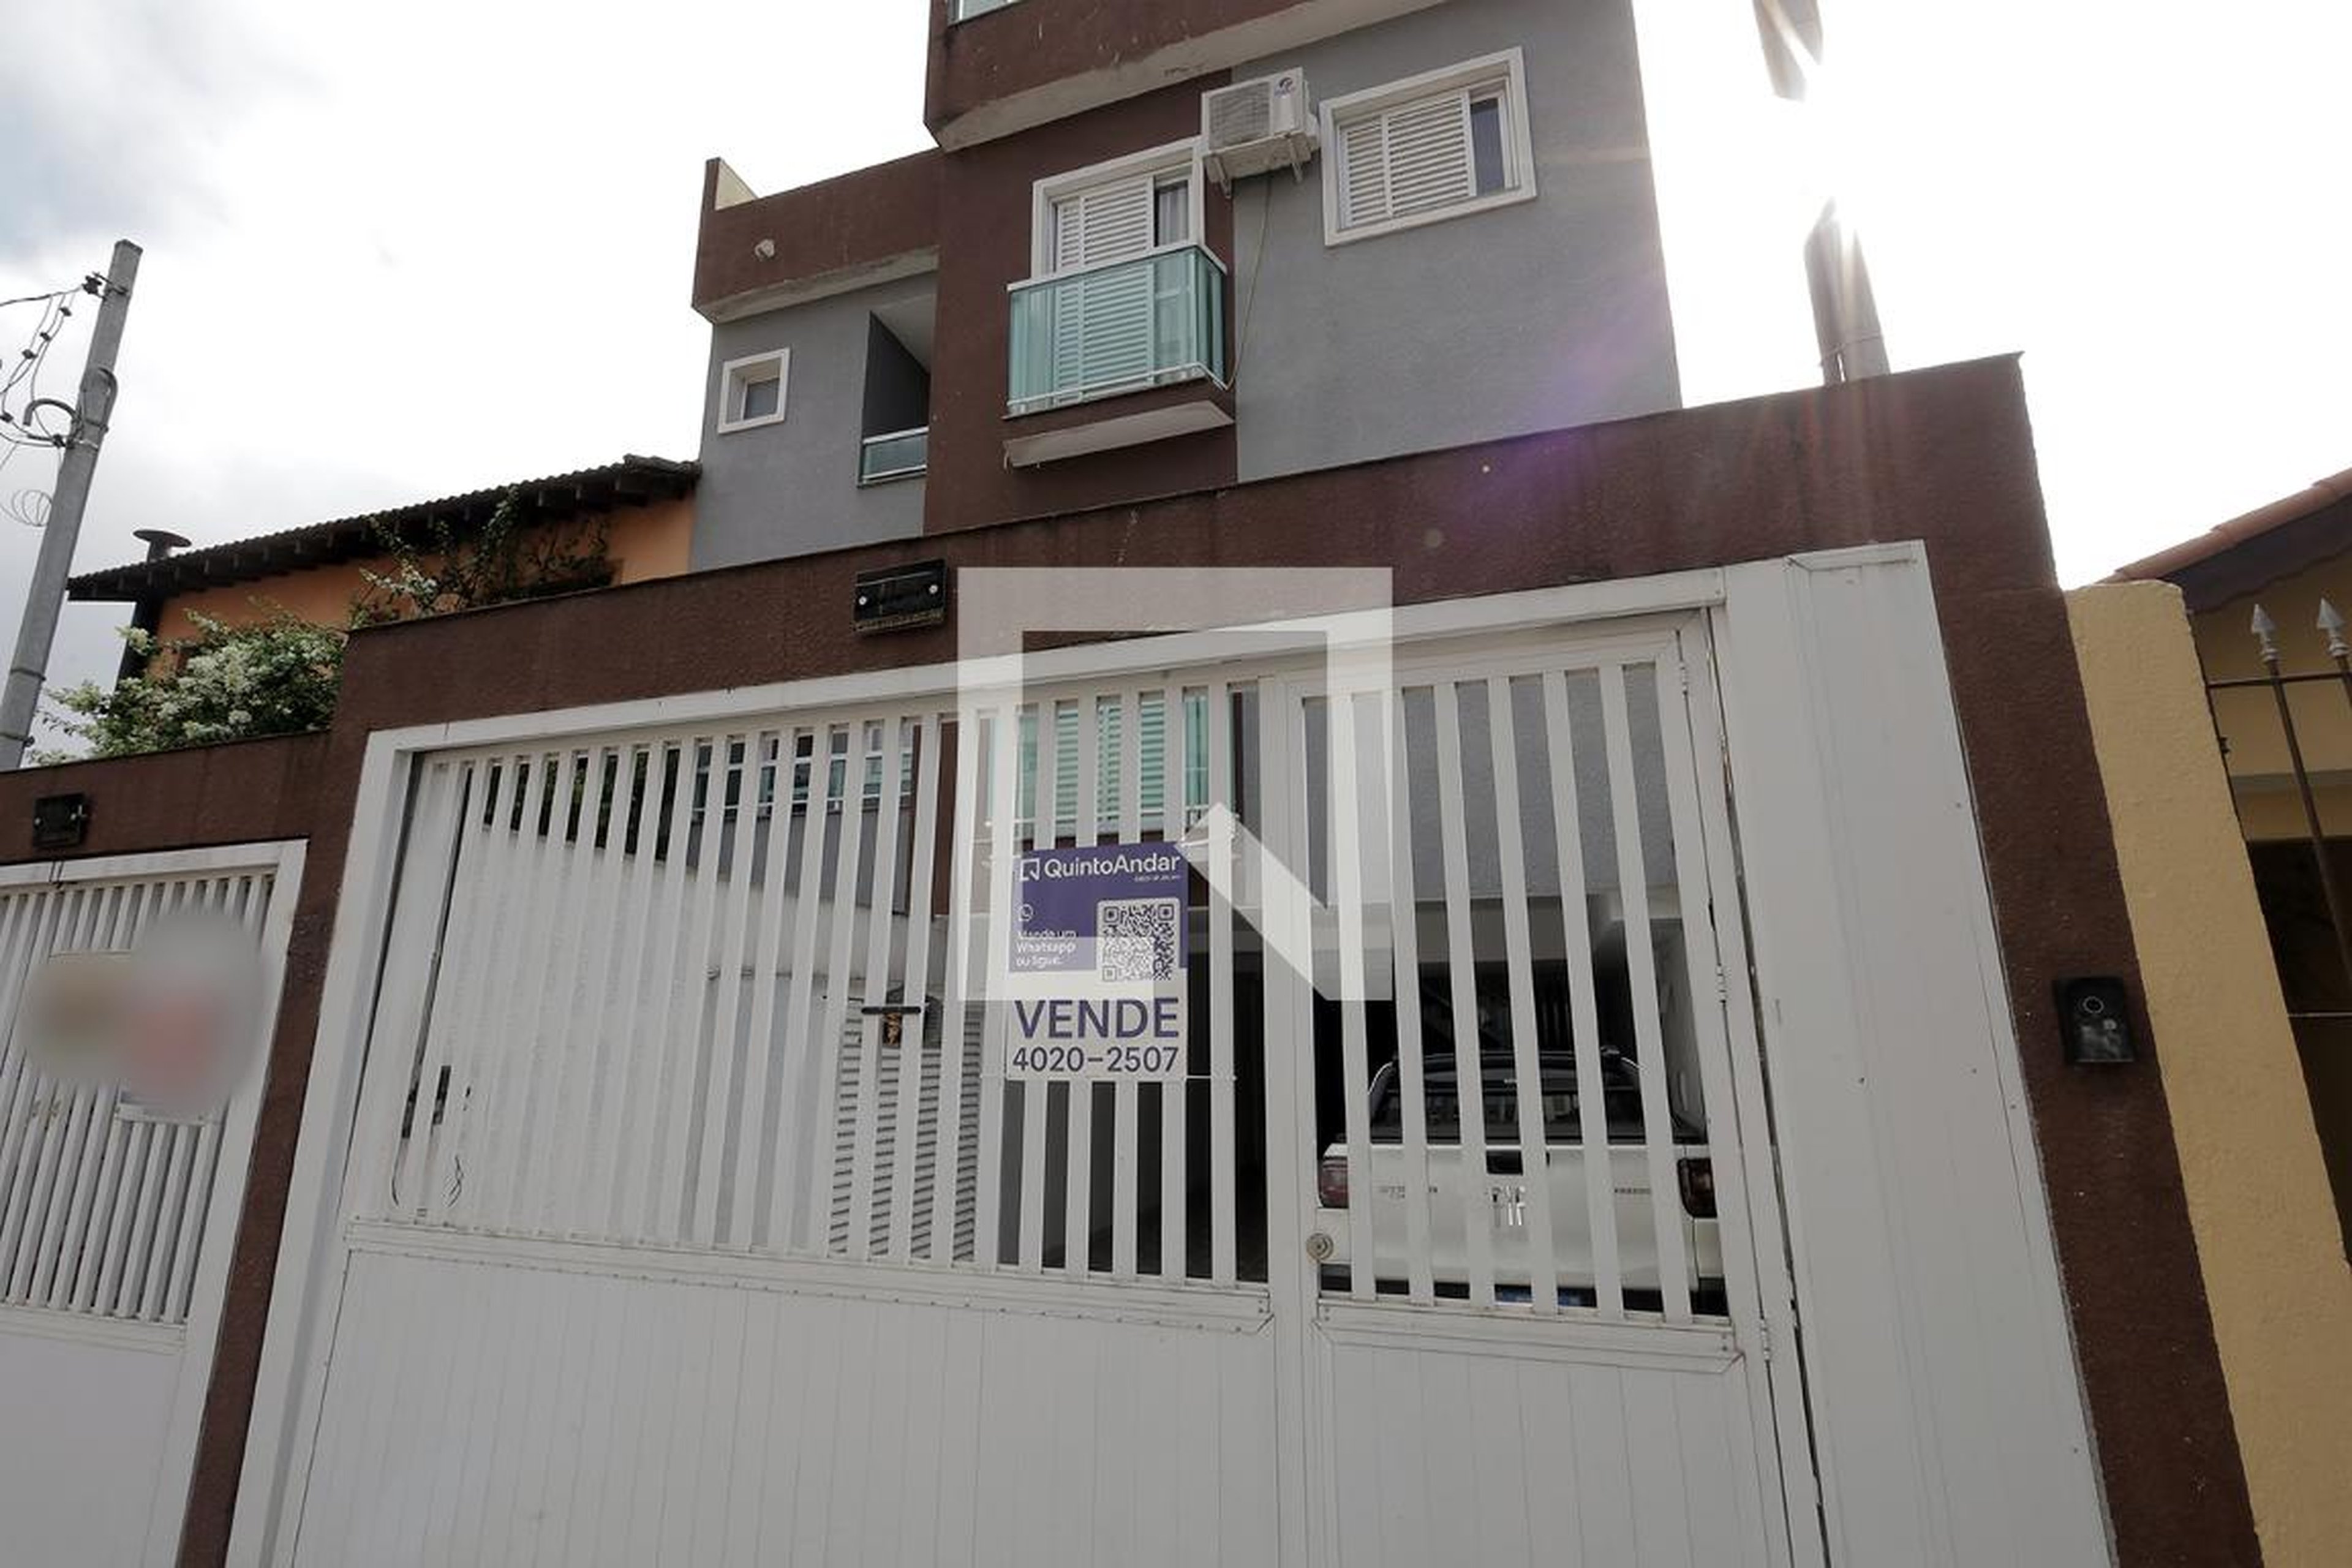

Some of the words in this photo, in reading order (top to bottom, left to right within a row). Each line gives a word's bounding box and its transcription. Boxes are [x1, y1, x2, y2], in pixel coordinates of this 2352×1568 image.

[1044, 852, 1181, 878] QuintoAndar
[1014, 997, 1179, 1038] VENDE
[1012, 1046, 1179, 1072] 4020-2507
